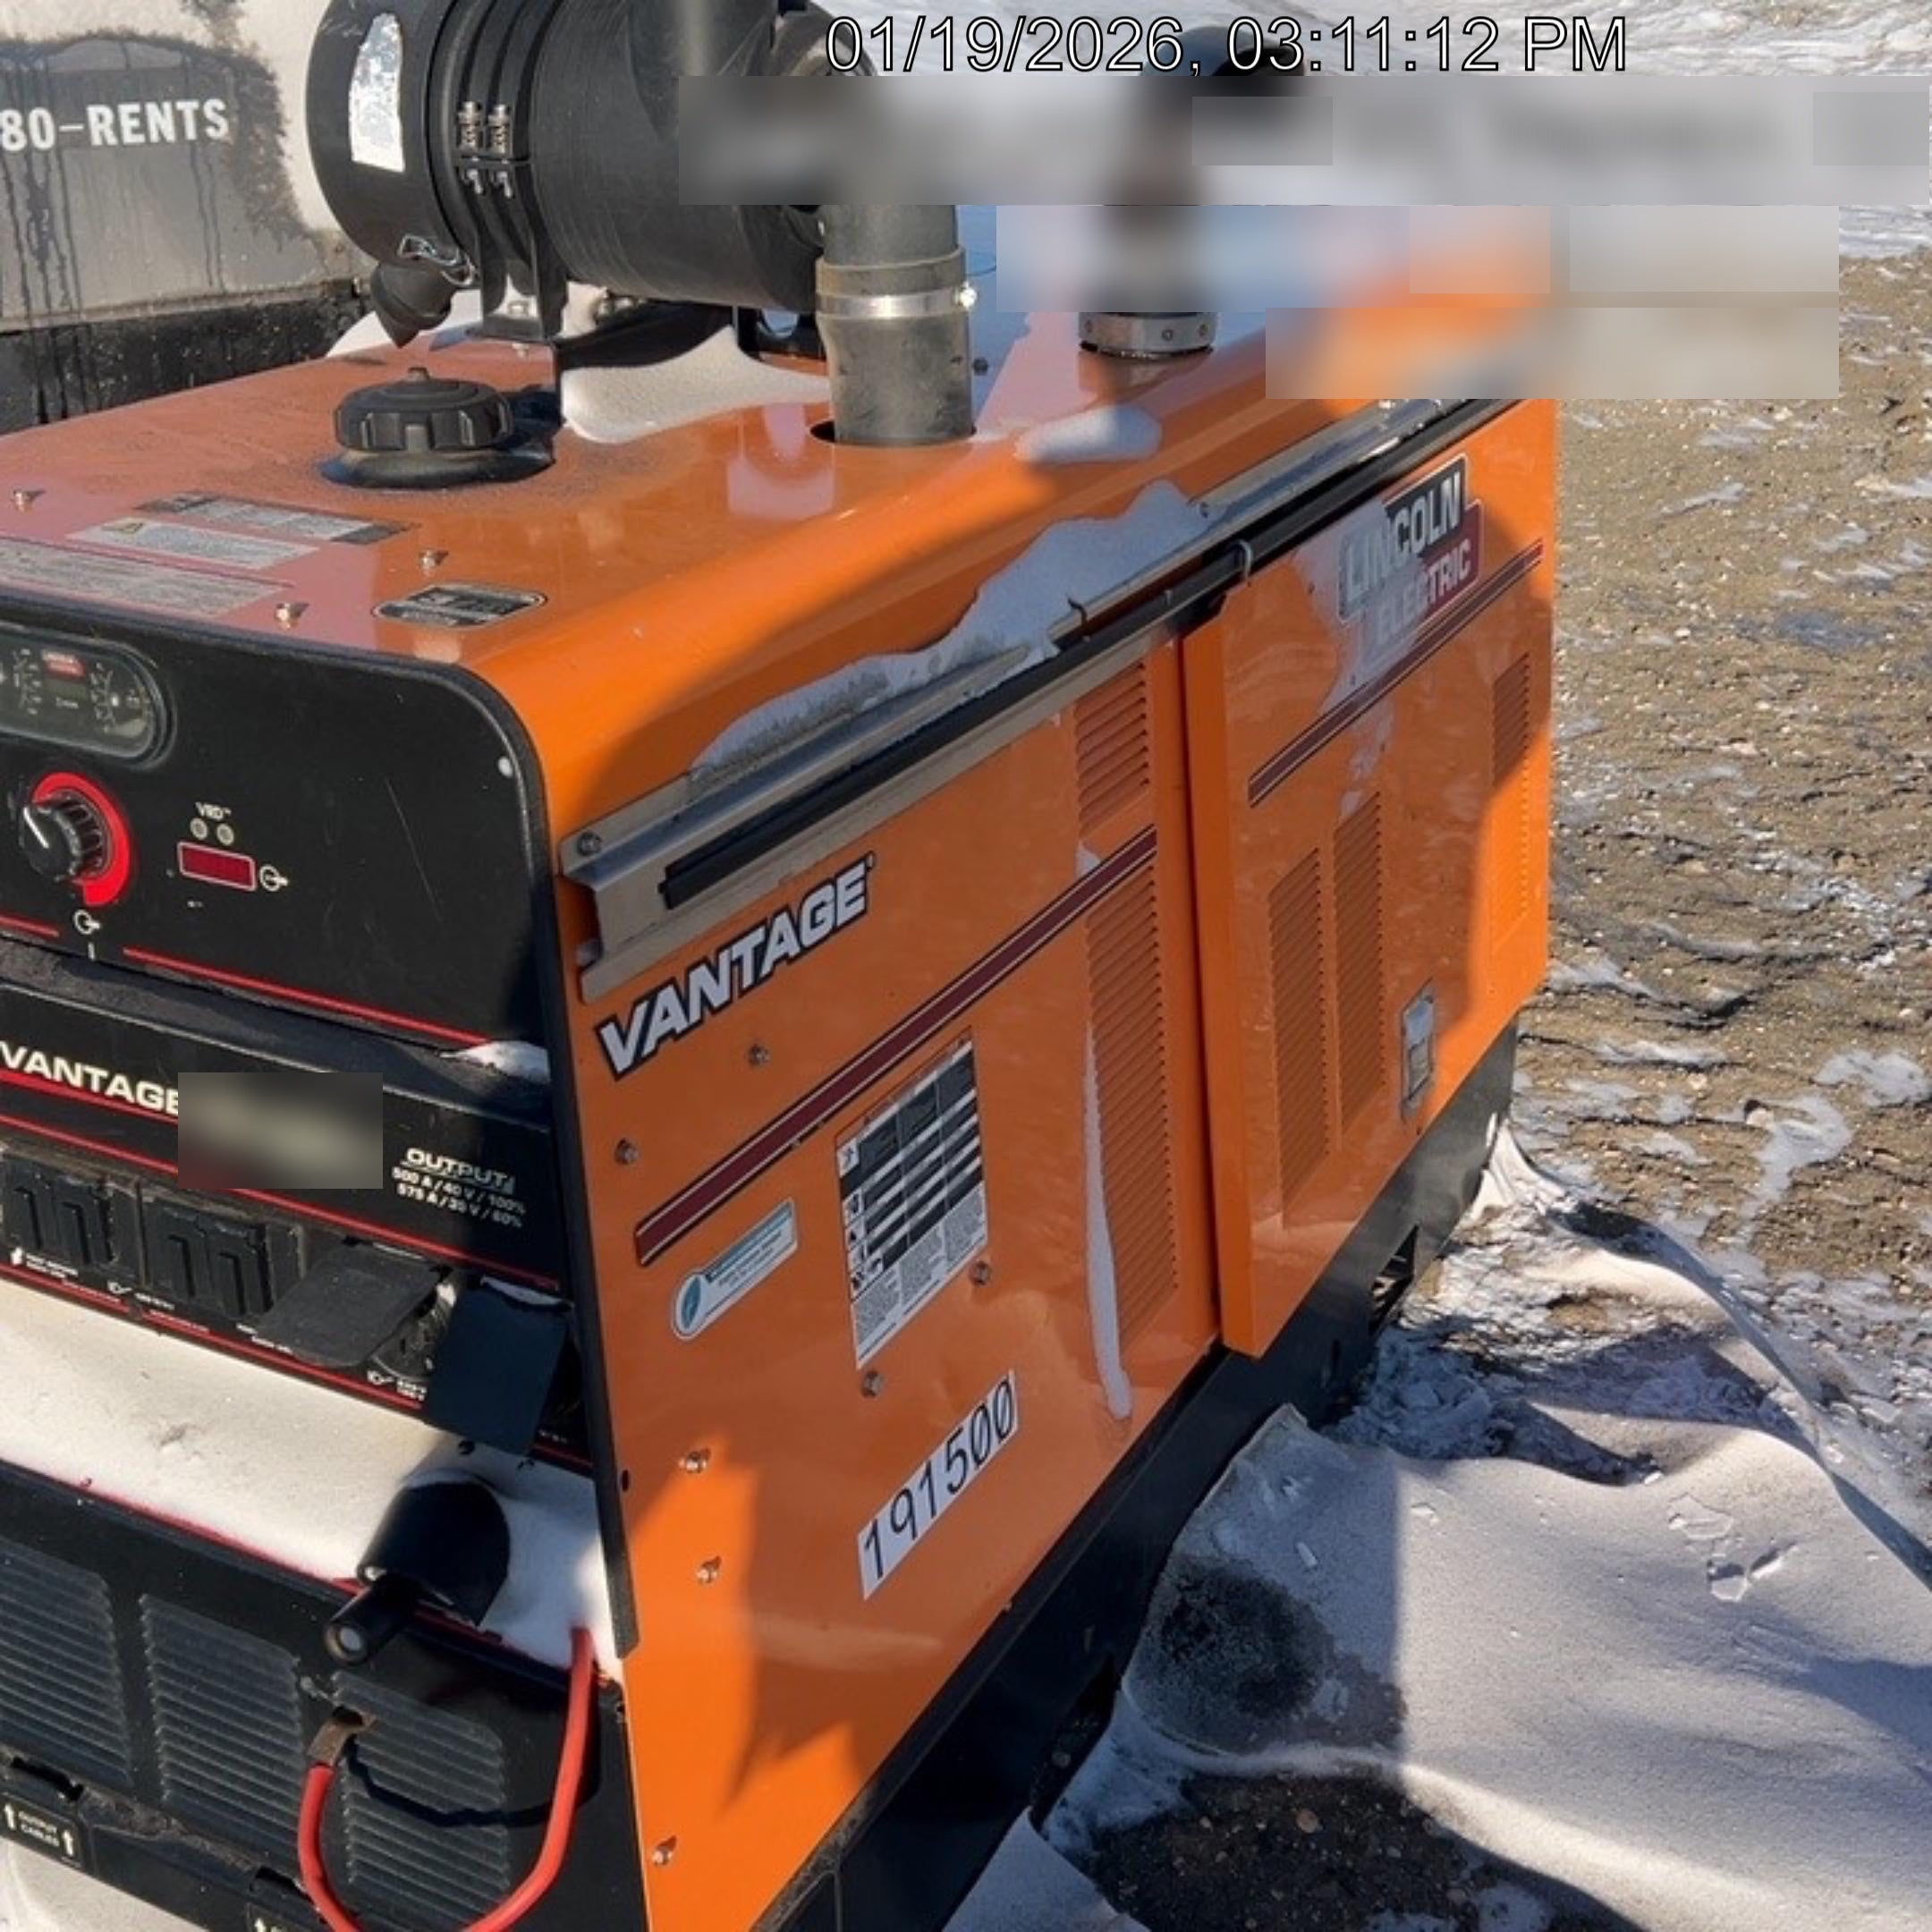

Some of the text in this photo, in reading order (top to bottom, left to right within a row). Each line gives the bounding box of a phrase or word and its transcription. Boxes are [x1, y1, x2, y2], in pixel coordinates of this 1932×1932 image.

[1346, 470, 1462, 603] LINCOLN
[1378, 538, 1472, 644] ELECTRIC
[595, 853, 869, 1076] VANTAGE
[407, 1148, 507, 1187] OUTPUT
[864, 1378, 1014, 1580] 191500
